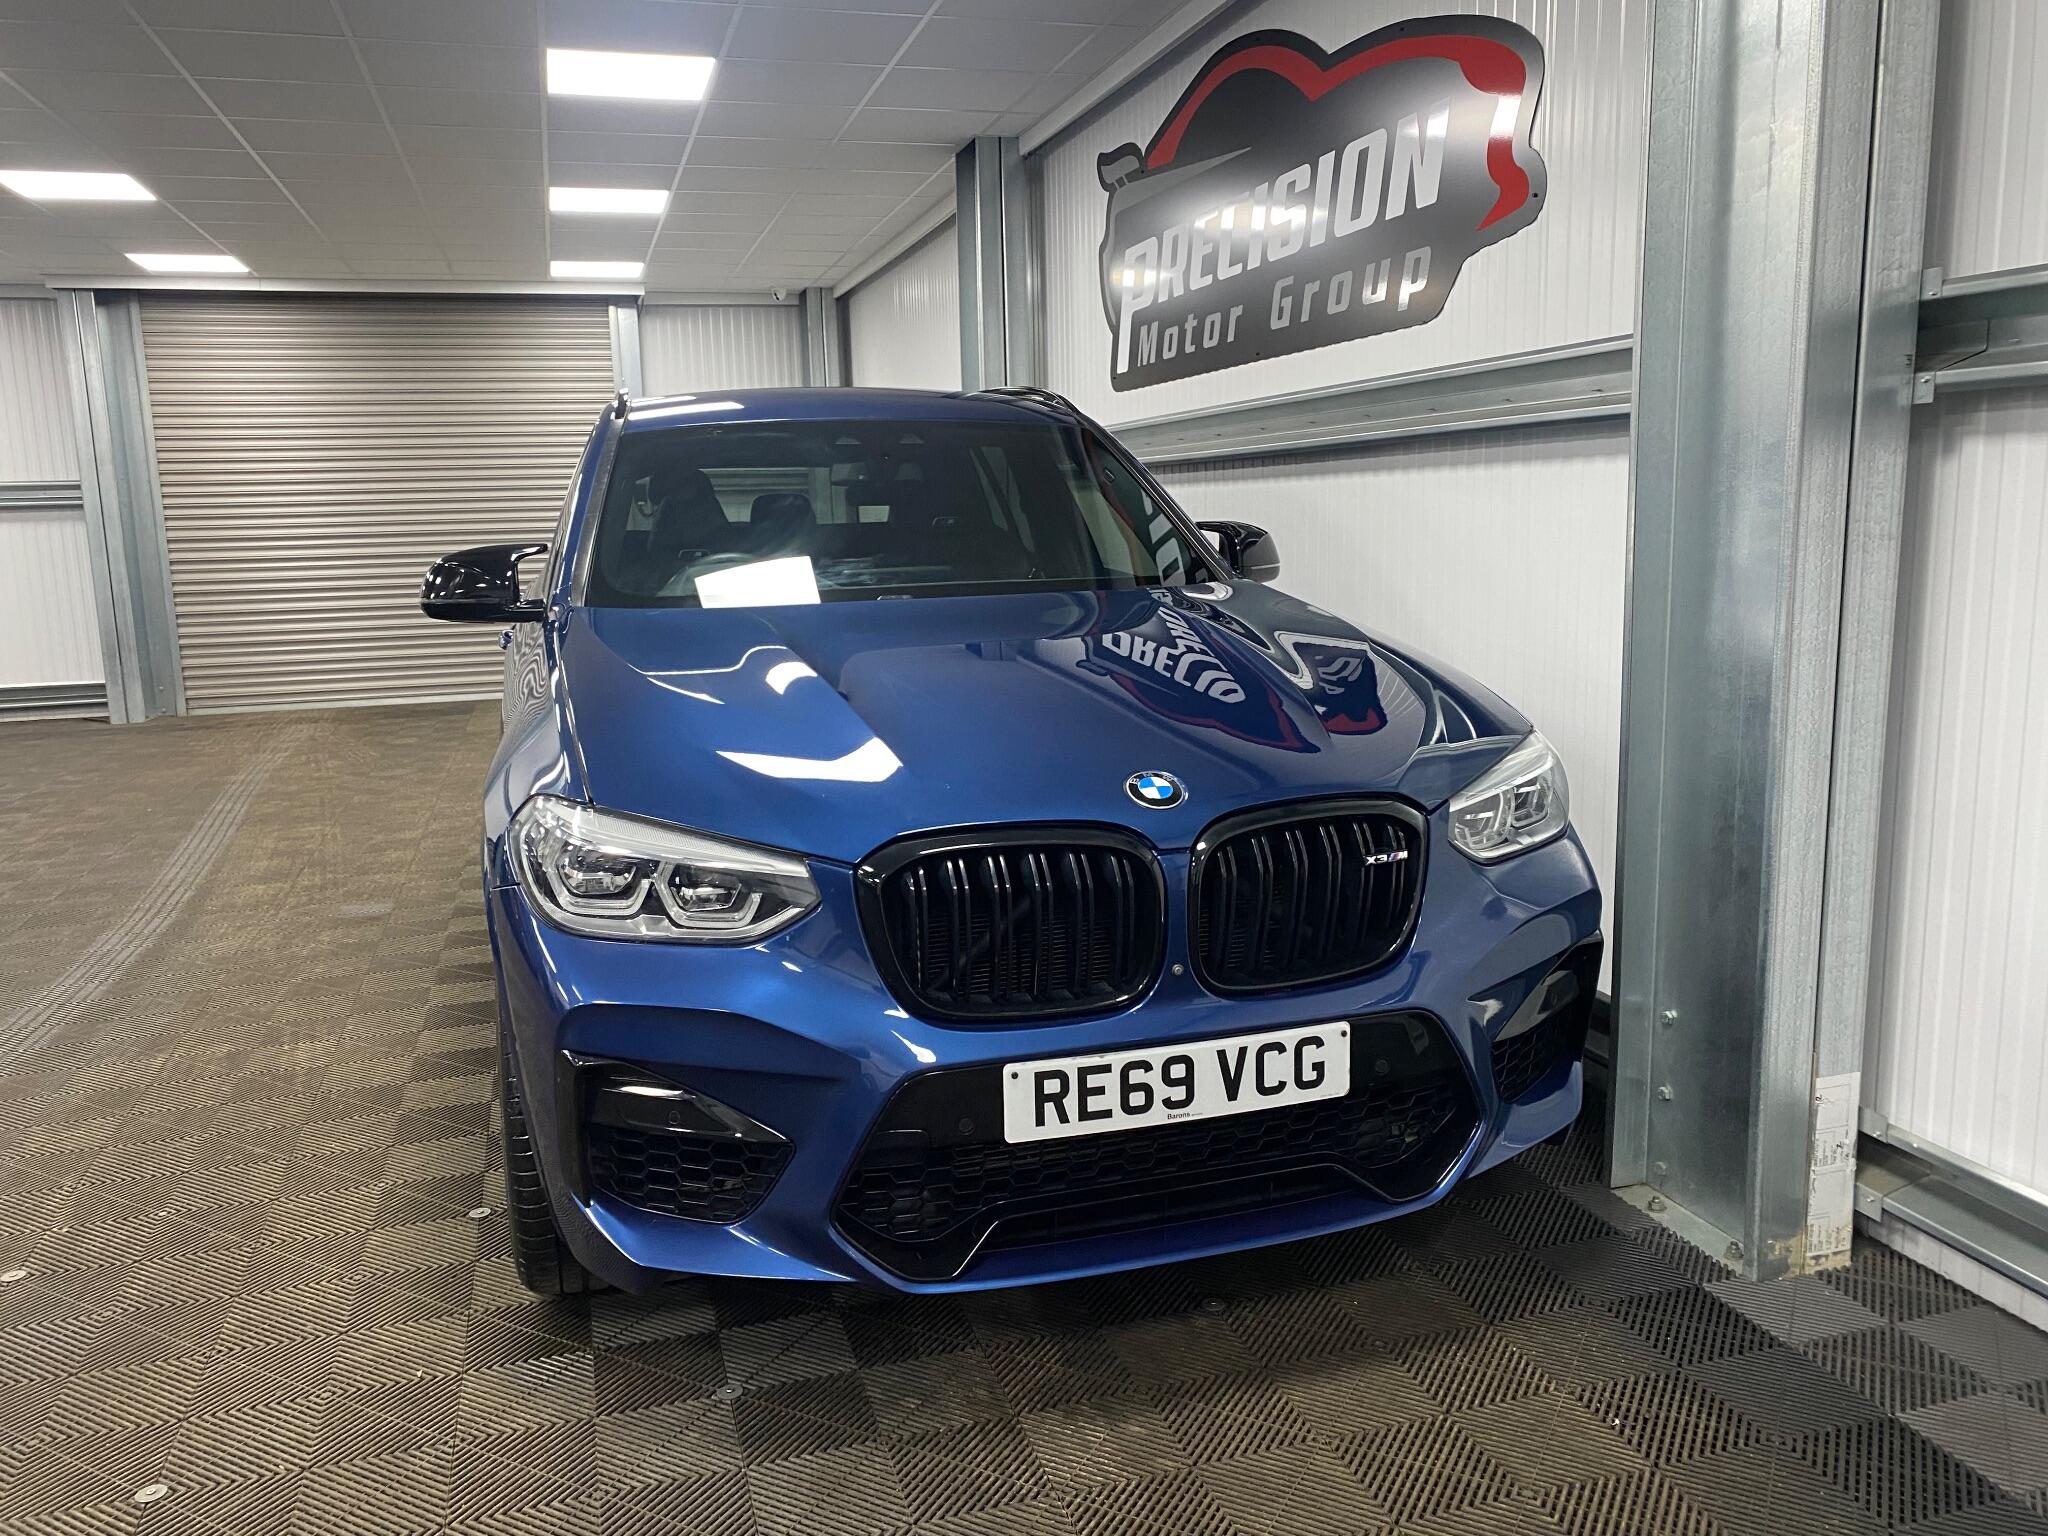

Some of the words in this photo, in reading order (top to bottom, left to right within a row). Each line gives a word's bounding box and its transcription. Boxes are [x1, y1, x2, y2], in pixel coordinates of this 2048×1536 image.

[1117, 103, 1450, 374] PRECISION
[1137, 304, 1243, 367] Motor
[1270, 247, 1431, 331] Group
[1034, 1054, 1195, 1127] RE69
[1216, 1035, 1325, 1102] VCG
[1167, 1112, 1191, 1120] Barons
